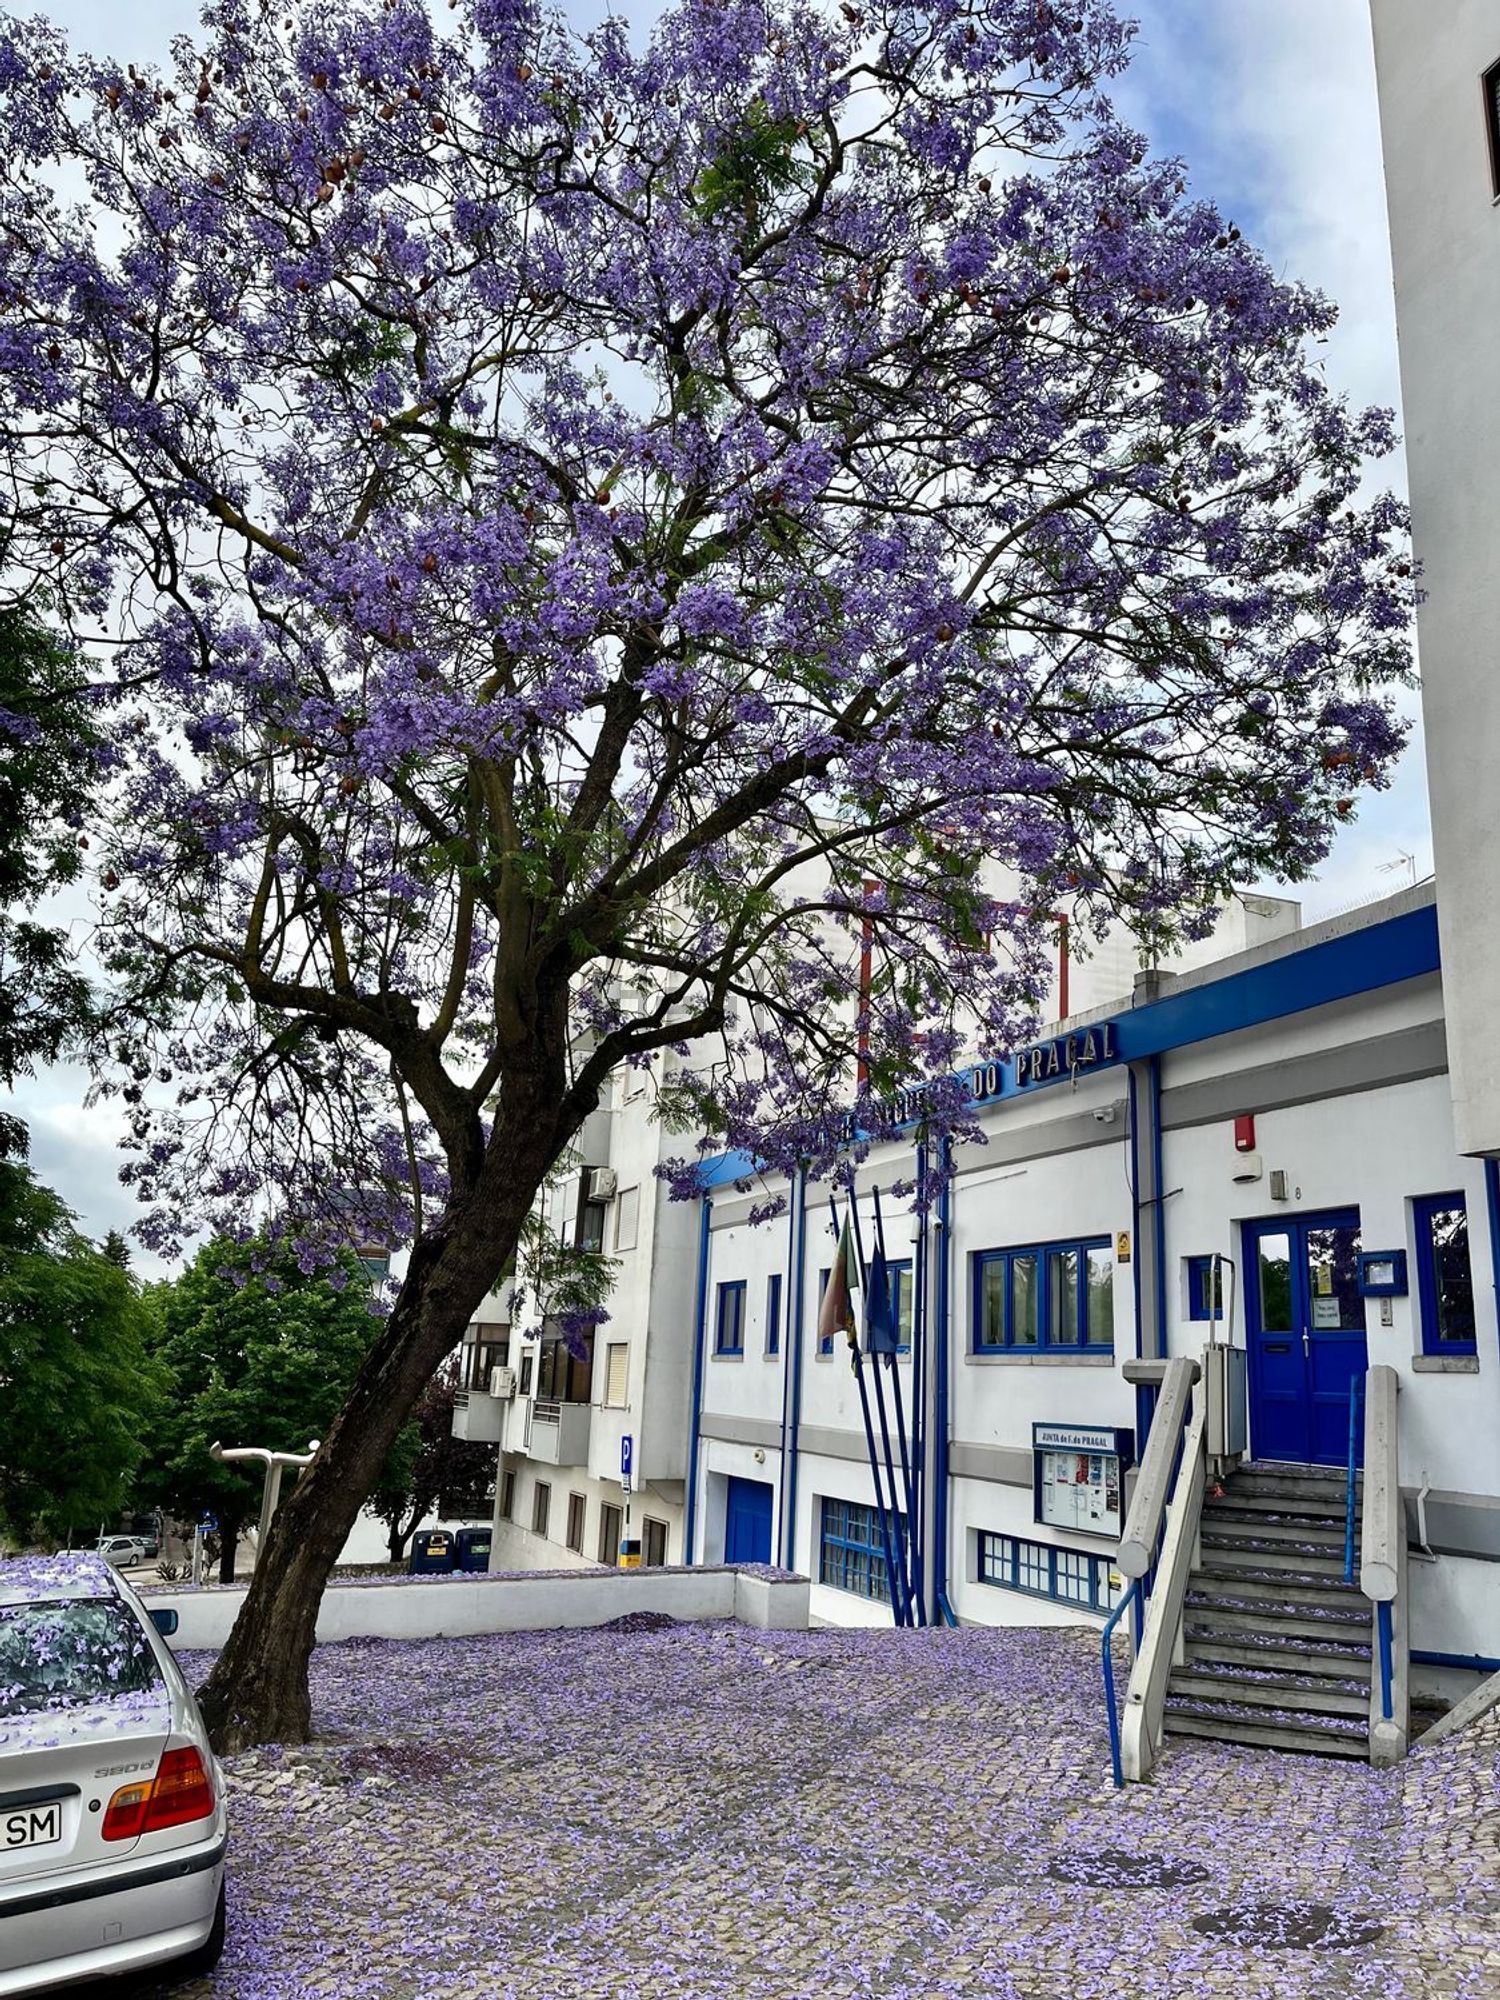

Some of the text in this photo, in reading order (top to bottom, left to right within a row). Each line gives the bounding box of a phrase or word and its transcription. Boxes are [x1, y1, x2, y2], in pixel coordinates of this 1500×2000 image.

[973, 1065, 998, 1099] DO
[1295, 1187, 1301, 1200] 8
[1042, 1432, 1059, 1442] JUNTA
[1082, 1436, 1108, 1447] PRAGAL
[622, 1439, 630, 1471] P
[94, 1759, 155, 1779] 320d
[6, 1809, 55, 1845] SM
